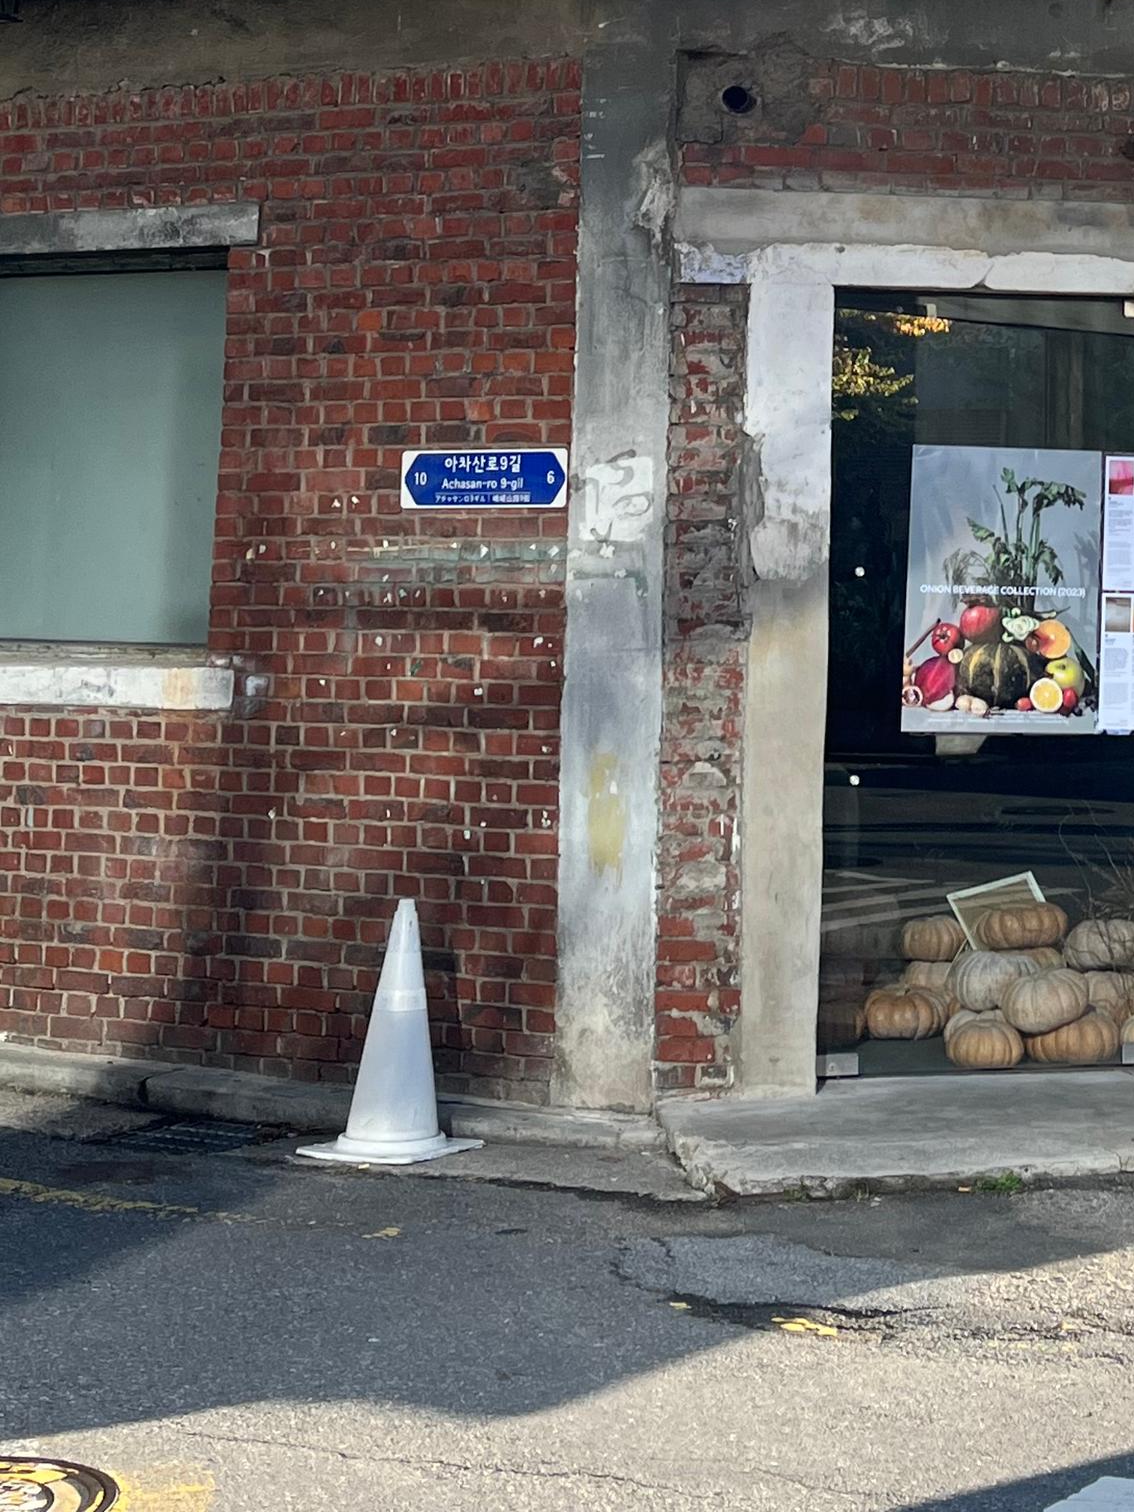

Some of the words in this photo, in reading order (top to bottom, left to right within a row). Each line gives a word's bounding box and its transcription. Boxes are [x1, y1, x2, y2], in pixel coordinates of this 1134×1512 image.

[444, 455, 521, 473] 아차산로9길
[414, 472, 427, 486] 10
[441, 478, 498, 490] Achasan-ro
[500, 477, 524, 491] 9-gil
[546, 471, 555, 484] 6
[919, 583, 951, 594] ONION
[953, 584, 999, 595] BEVERAGE
[1000, 586, 1057, 597] COLLECTION
